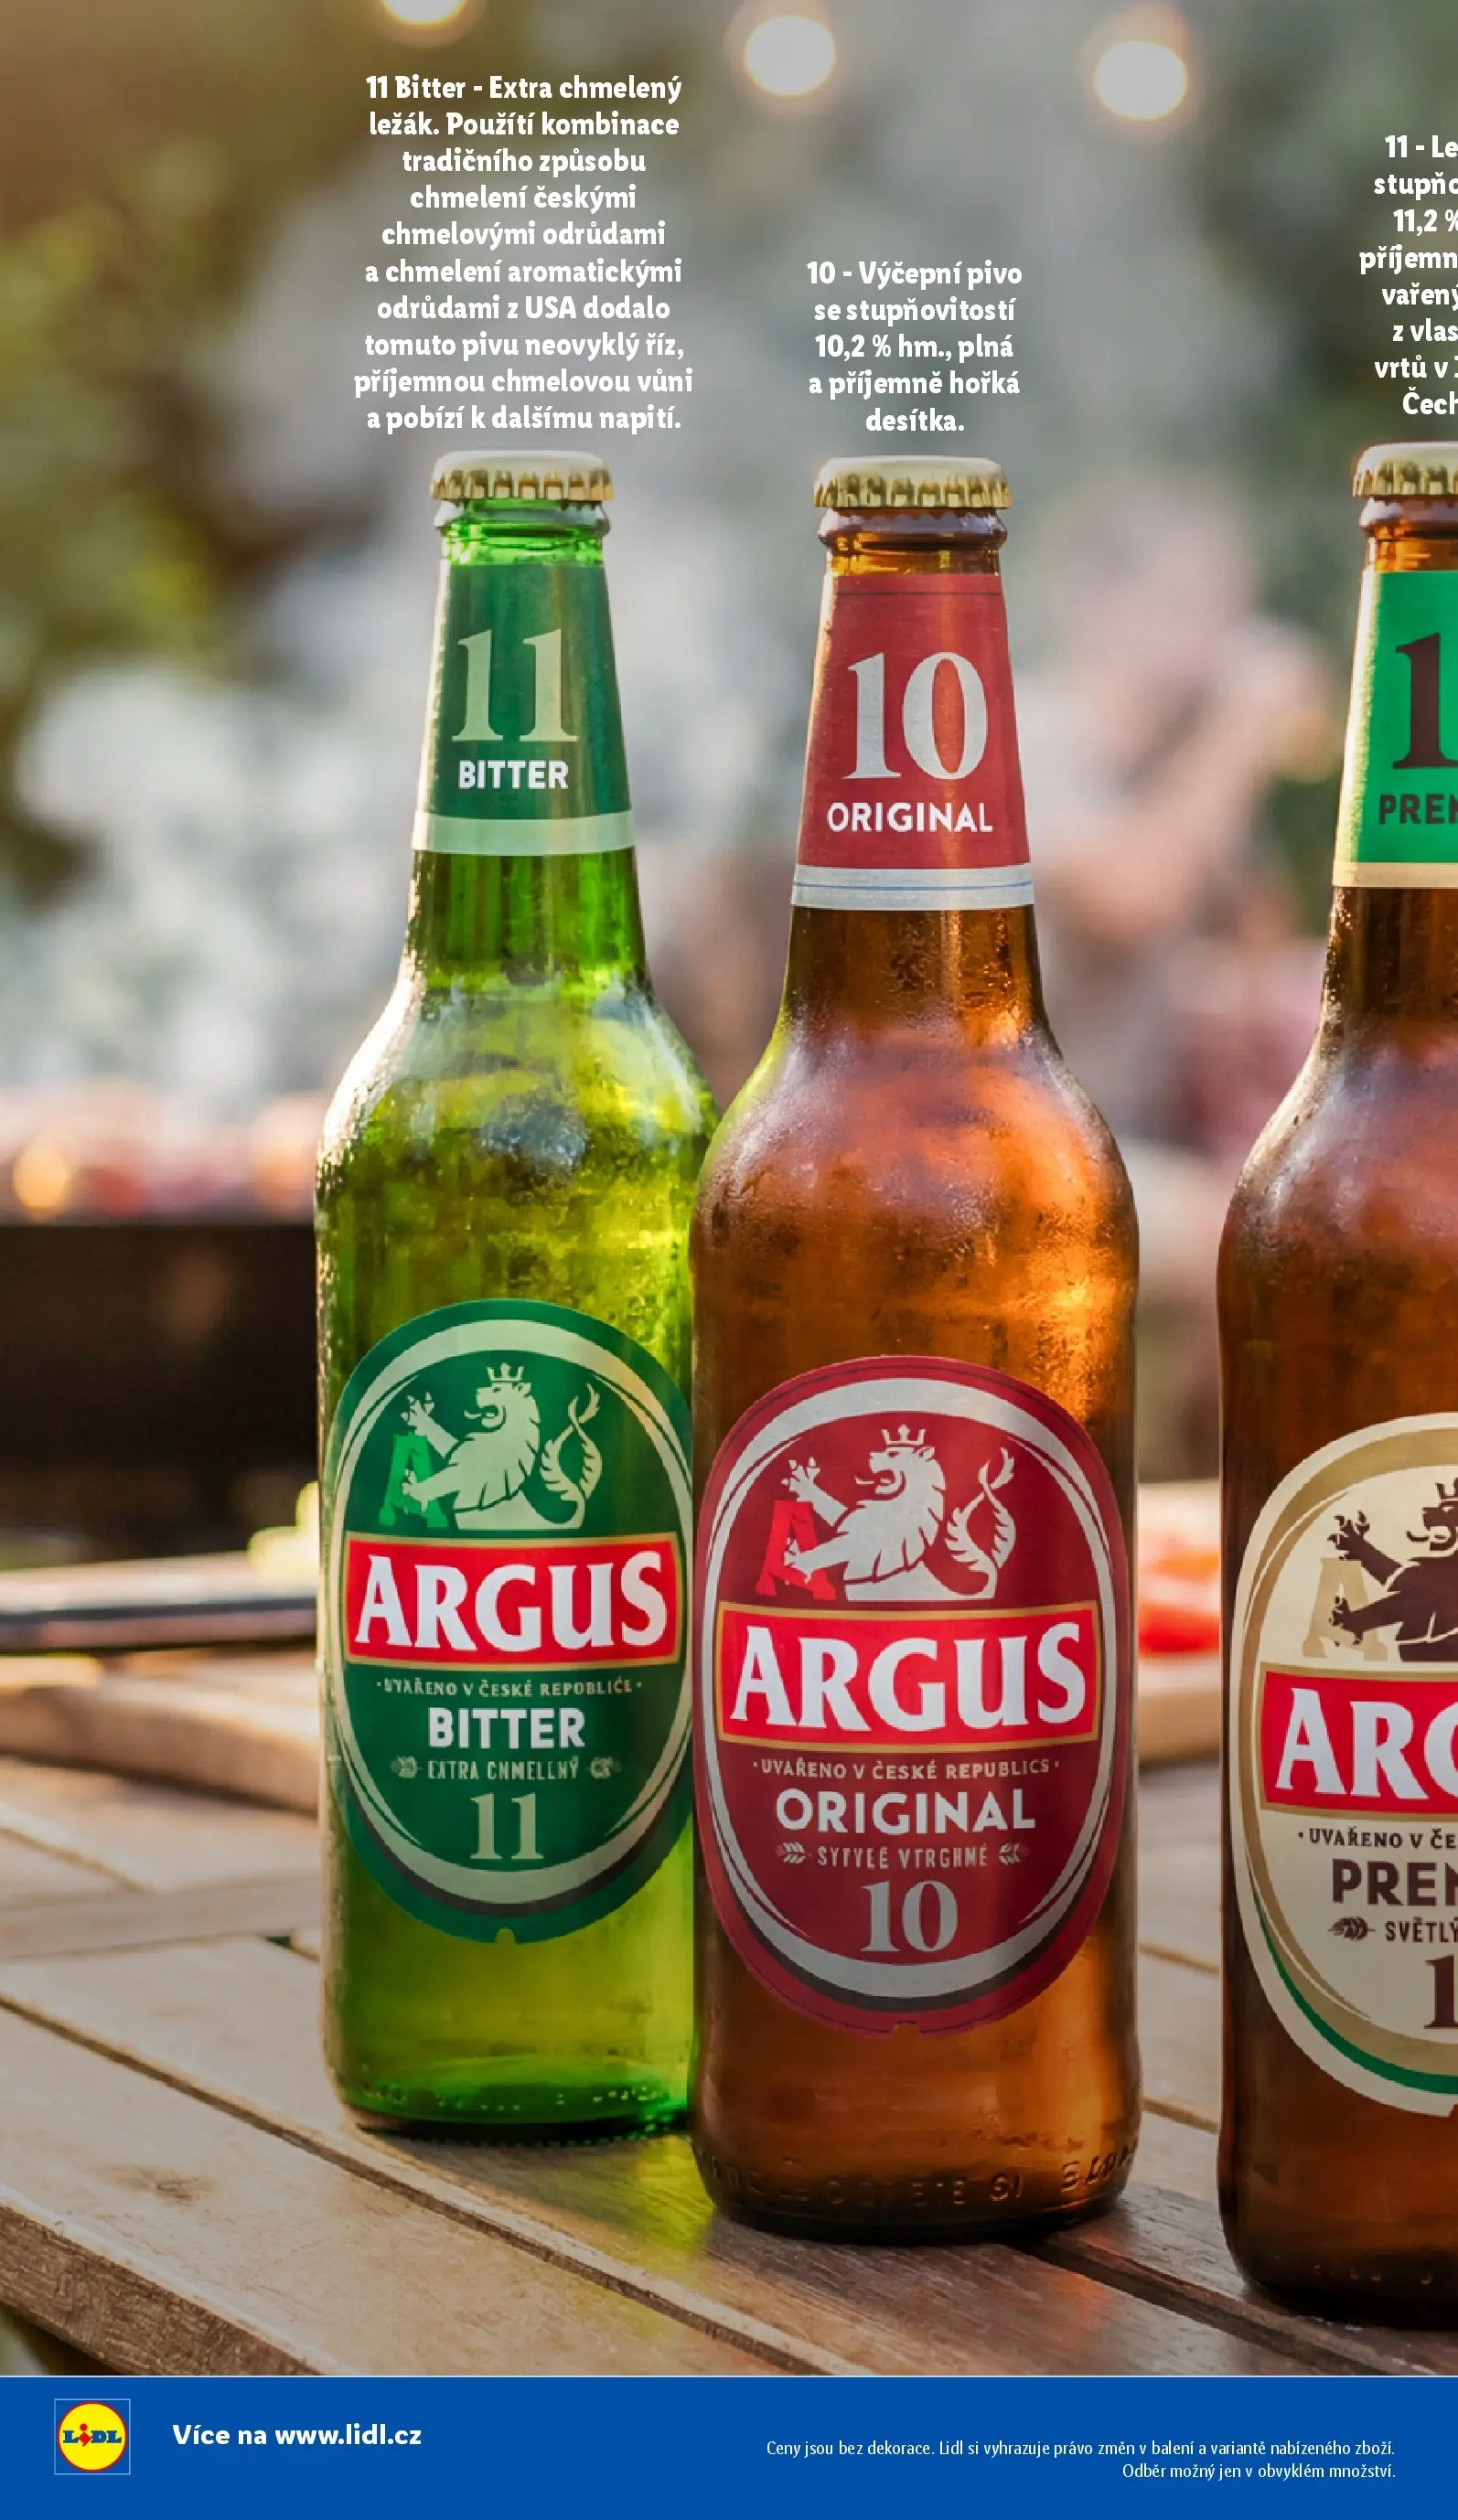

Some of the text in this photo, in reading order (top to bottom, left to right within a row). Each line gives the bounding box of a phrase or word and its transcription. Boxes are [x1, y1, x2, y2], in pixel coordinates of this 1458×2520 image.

[452, 628, 578, 742] 11
[842, 652, 988, 780] 10
[458, 760, 569, 789] BITTER
[827, 802, 992, 833] ORIGINAL
[355, 1551, 668, 1651] ARGUS
[463, 1682, 474, 1697] V
[478, 1679, 532, 1698] ČESKÉ
[730, 1622, 1086, 1732] ARGUS
[428, 1707, 585, 1748] BITTER
[852, 1763, 865, 1779] V
[873, 1759, 937, 1779] ČESKÉ
[470, 1792, 544, 1860] 11
[777, 1789, 1035, 1835] ORIGINAL
[1309, 1826, 1403, 1849] UVAŘENO
[1409, 1833, 1423, 1849] V
[861, 1880, 958, 1952] 10
